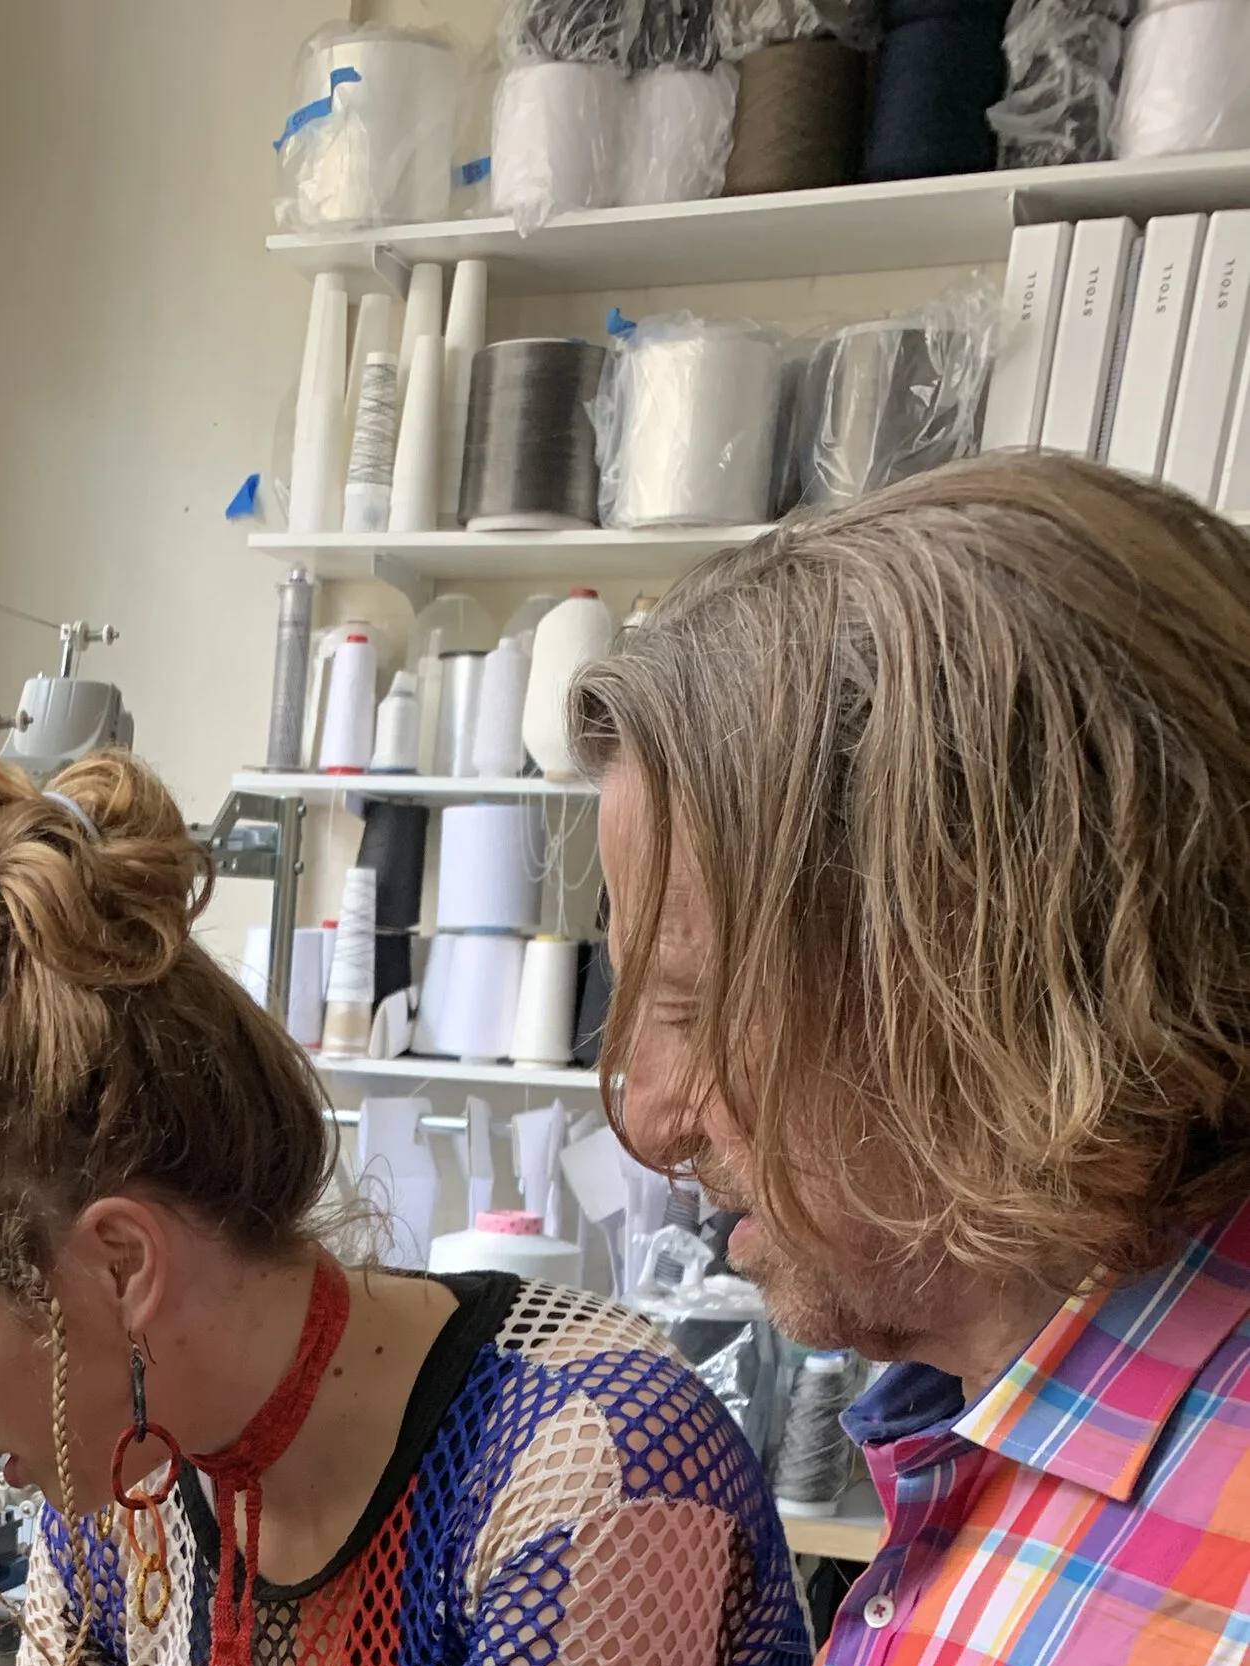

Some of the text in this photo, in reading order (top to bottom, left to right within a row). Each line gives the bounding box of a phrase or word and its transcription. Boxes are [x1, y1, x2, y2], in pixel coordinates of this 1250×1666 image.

[1021, 270, 1038, 321] STOLL
[1083, 266, 1100, 317] STOLL
[1156, 262, 1174, 314] STOLL
[1217, 257, 1236, 309] STOLL
